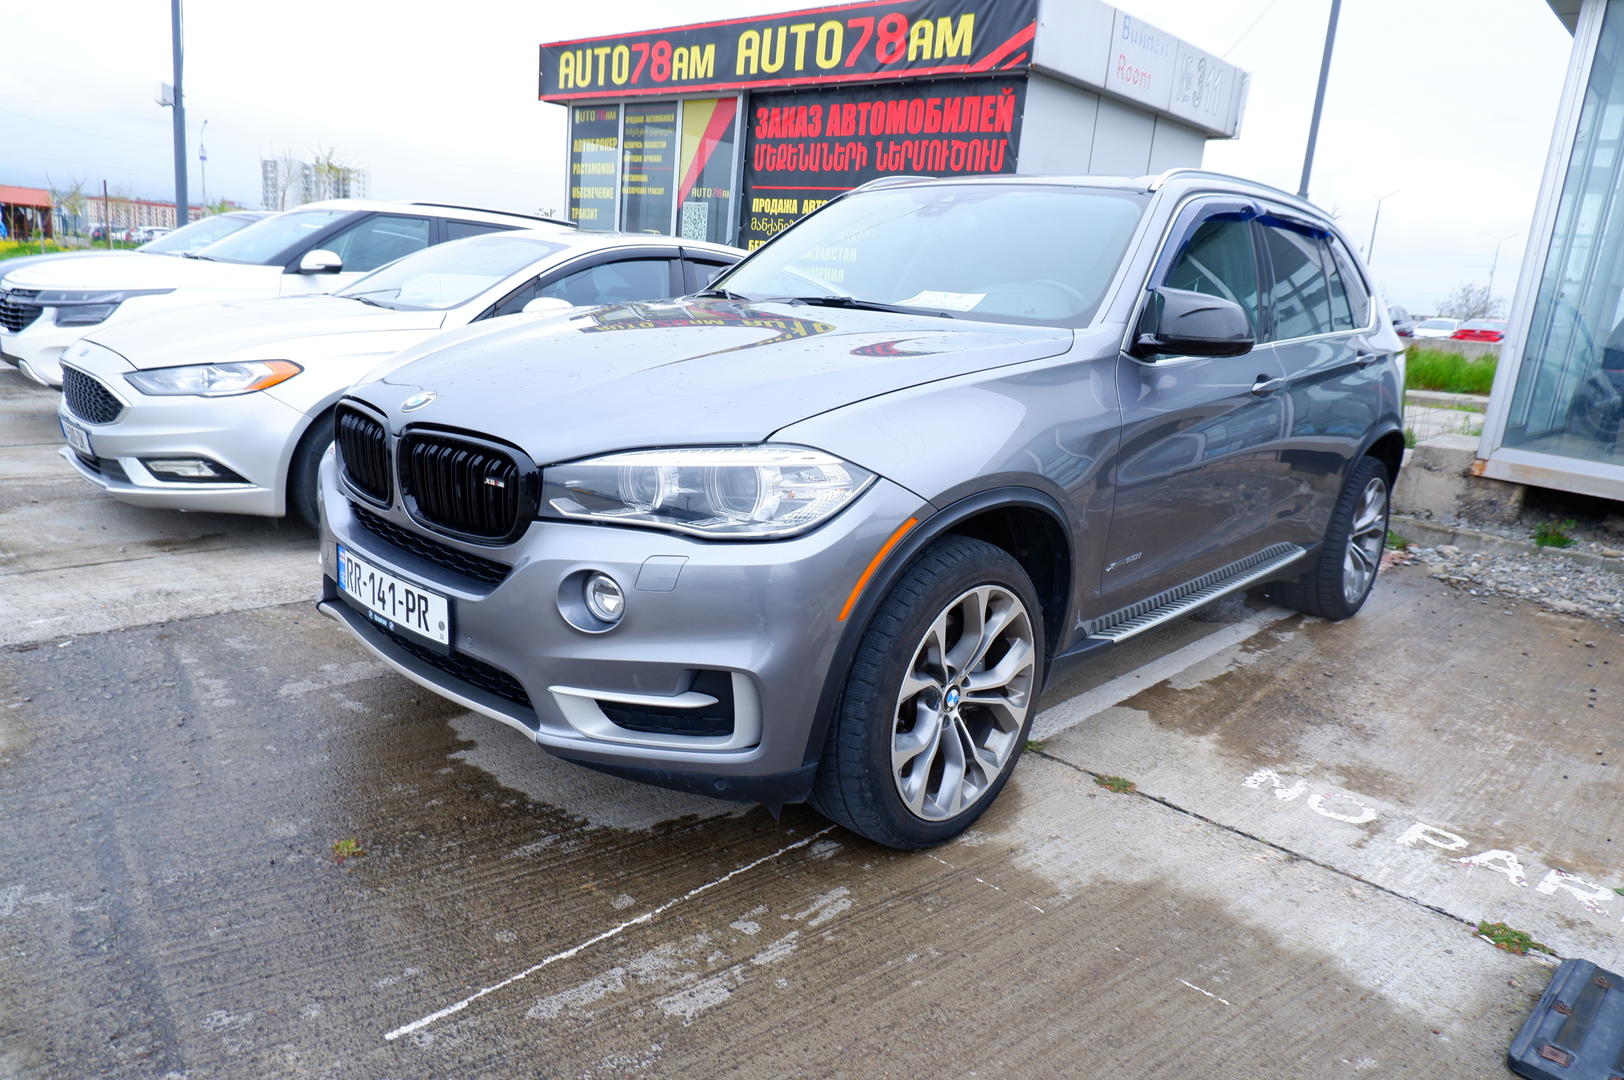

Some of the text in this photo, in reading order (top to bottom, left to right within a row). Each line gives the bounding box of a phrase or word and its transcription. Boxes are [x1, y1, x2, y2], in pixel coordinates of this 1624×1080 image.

[558, 40, 715, 90] AUTO78AM
[735, 13, 975, 77] AUTO78AM
[1116, 54, 1152, 90] Room
[755, 88, 1016, 139] ЗАКАЗ АВТОМОБИЛЕЙ
[571, 207, 599, 220] ТРАНЗИТ
[572, 187, 614, 199] ОБЕСПЕЧЕНИЕ
[752, 198, 798, 215] ПРОДАЖА
[346, 556, 430, 632] RR-141-PR
[1397, 821, 1624, 922] PAR
